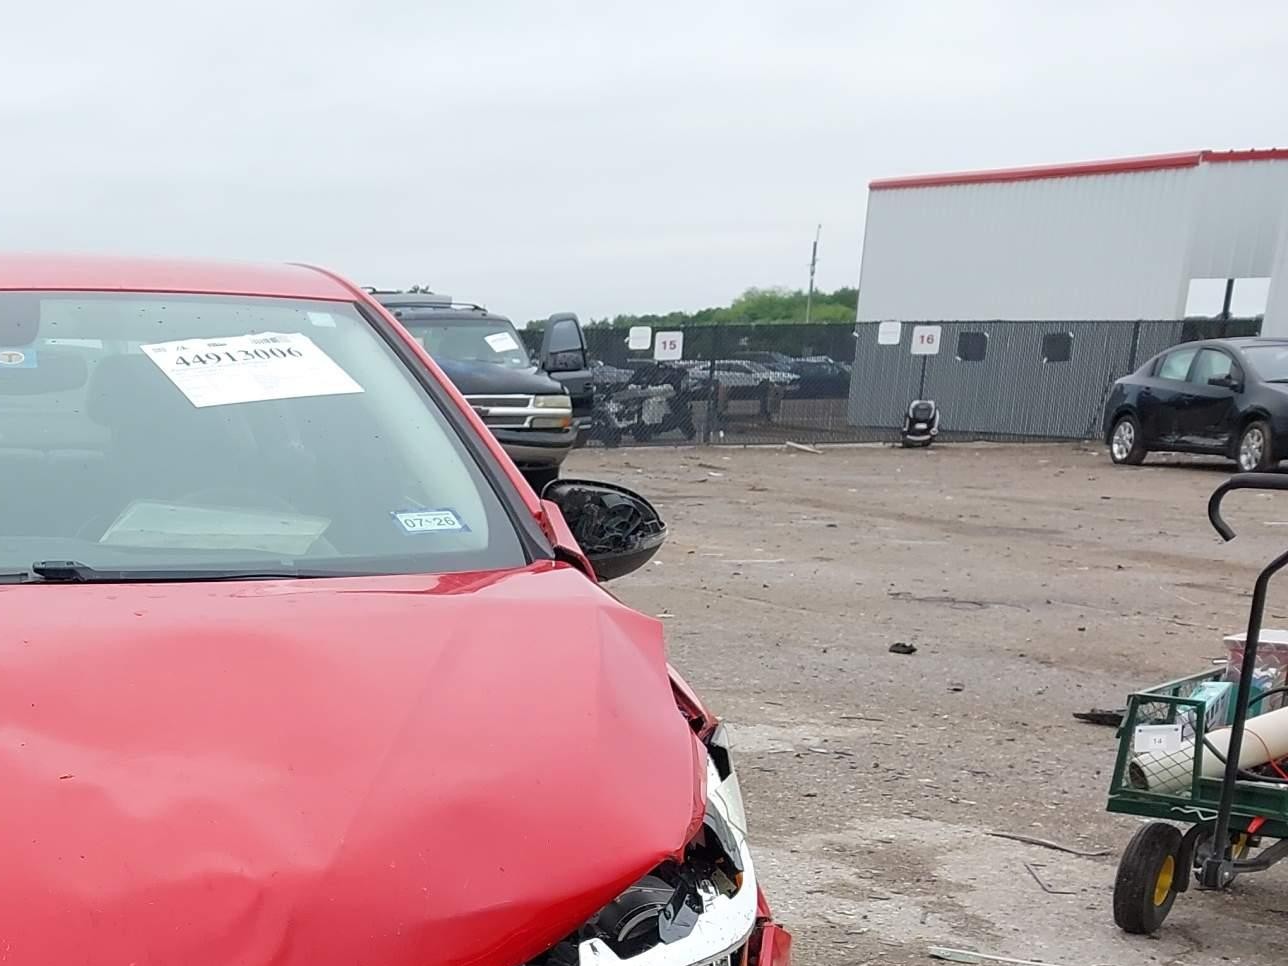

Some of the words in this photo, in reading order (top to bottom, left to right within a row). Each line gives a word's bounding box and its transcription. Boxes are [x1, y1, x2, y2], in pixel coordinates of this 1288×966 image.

[661, 339, 678, 351] 15
[918, 333, 935, 345] 16
[175, 346, 304, 367] 44913006
